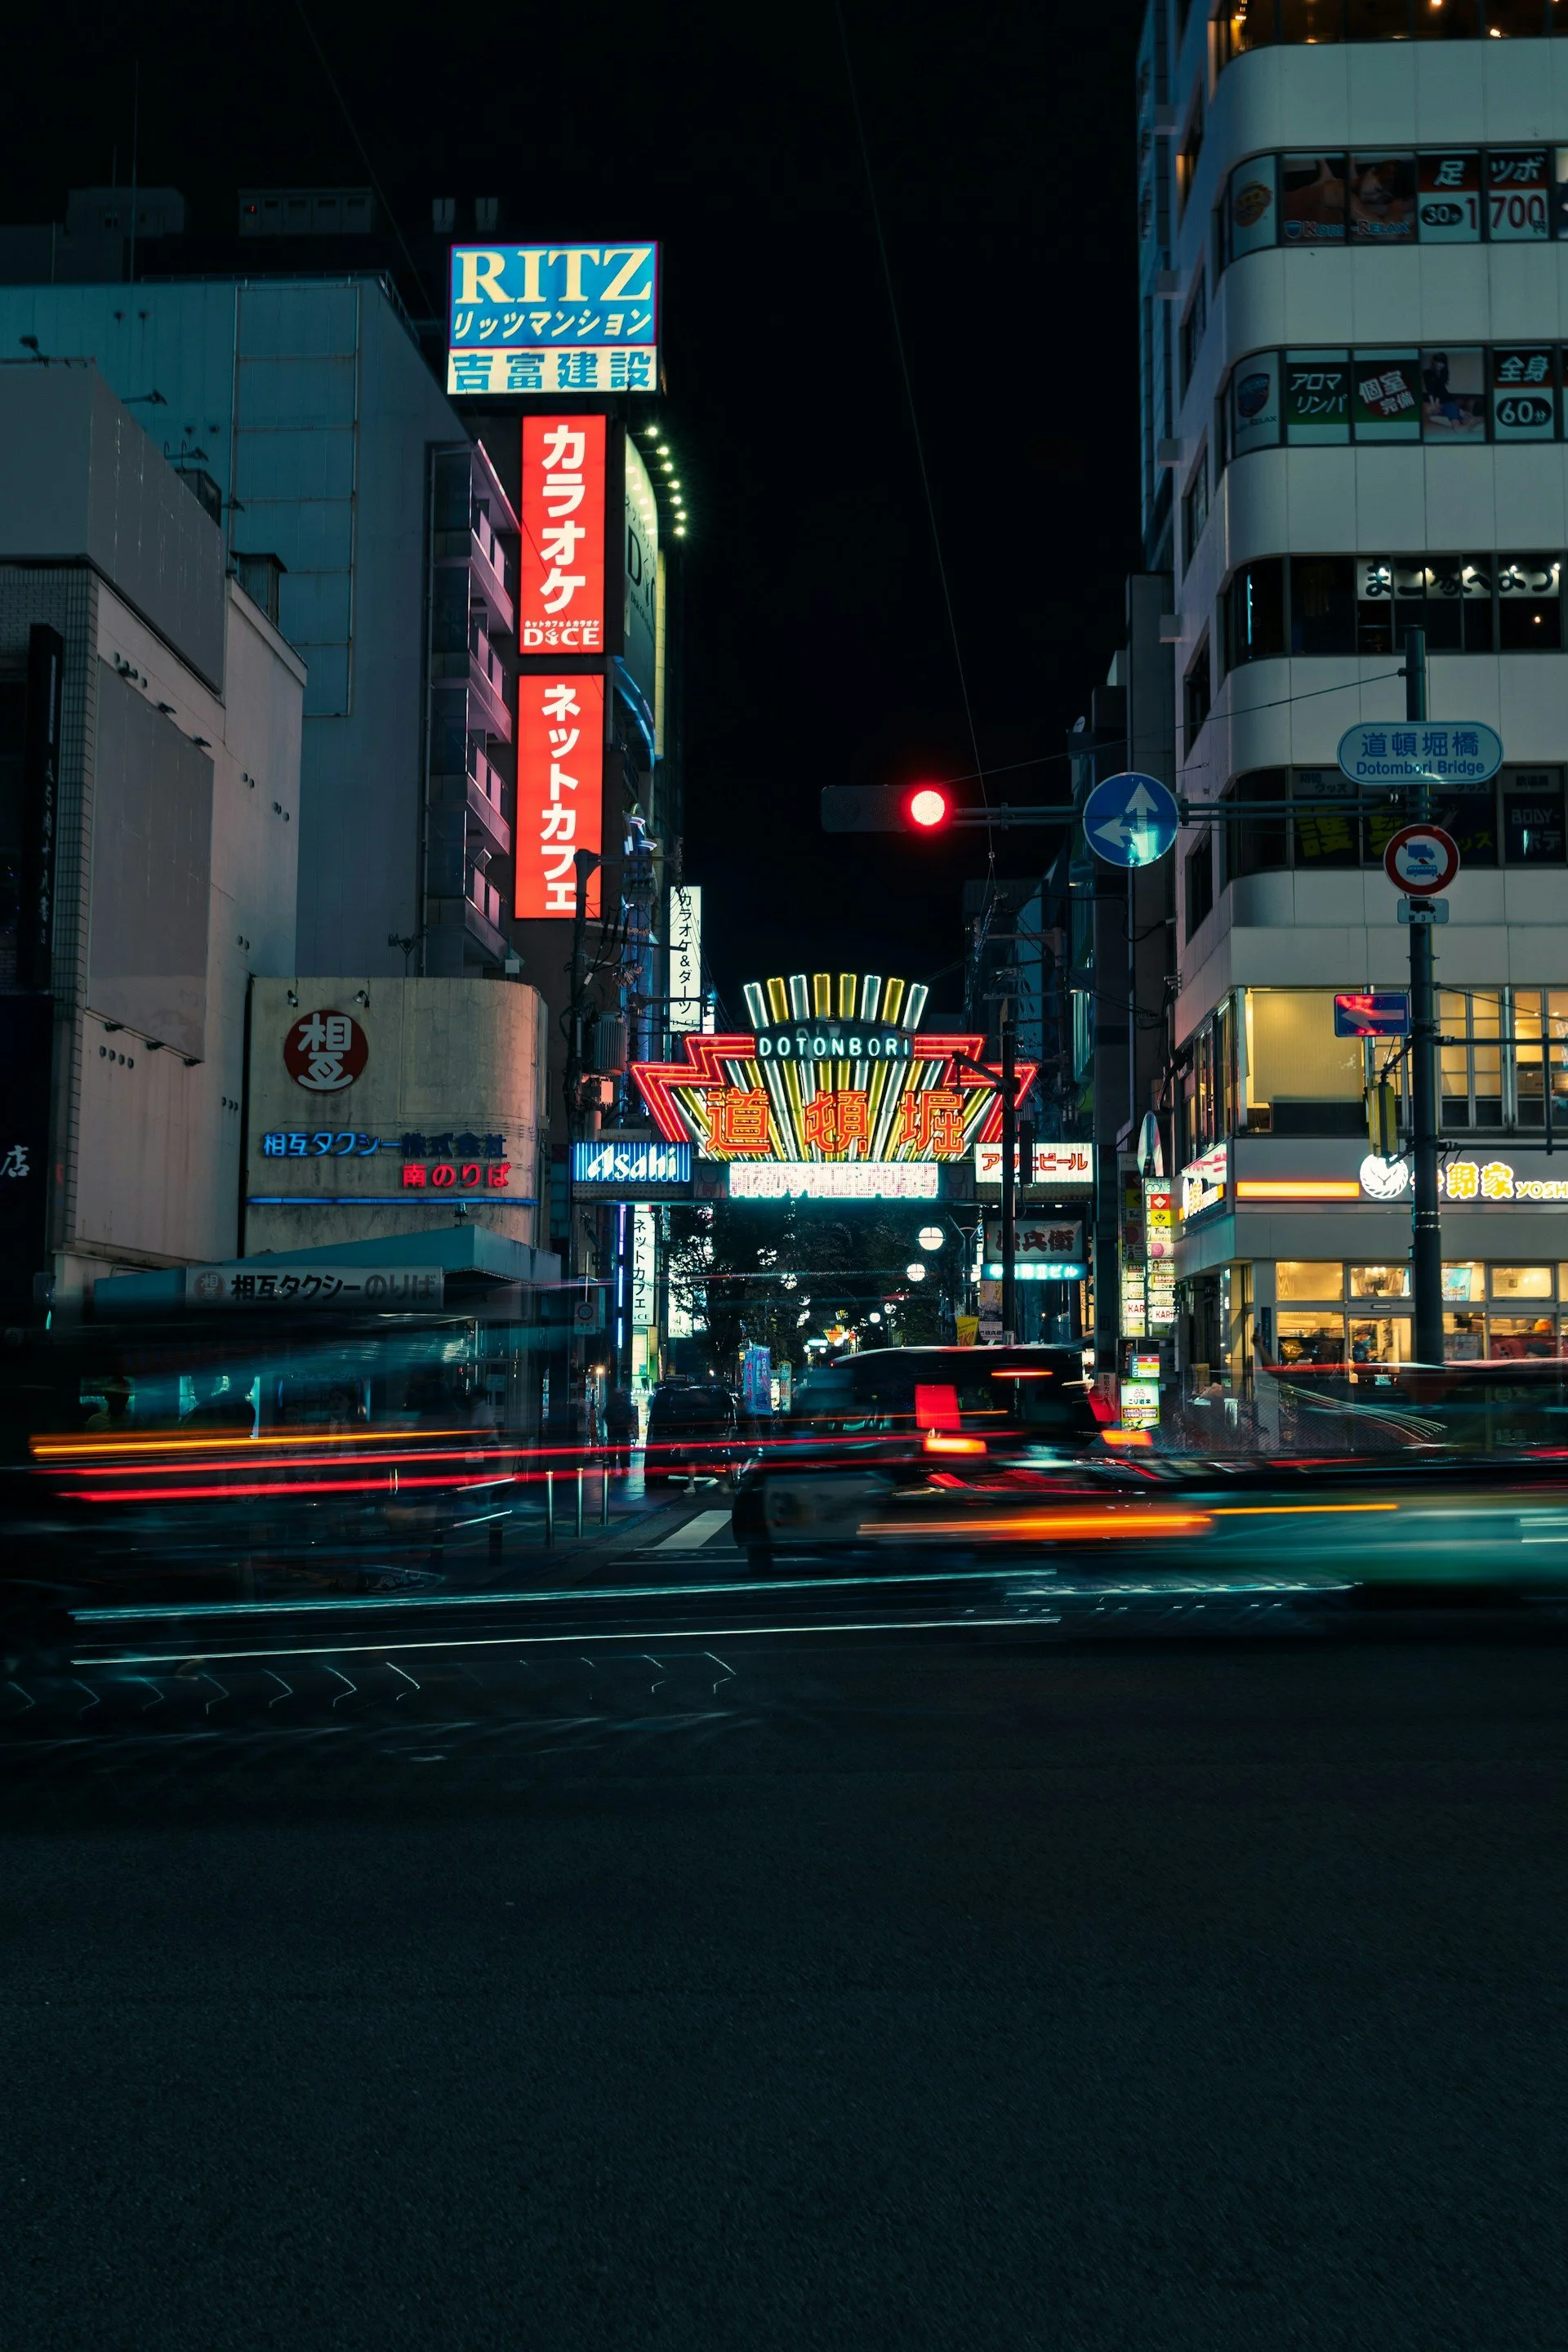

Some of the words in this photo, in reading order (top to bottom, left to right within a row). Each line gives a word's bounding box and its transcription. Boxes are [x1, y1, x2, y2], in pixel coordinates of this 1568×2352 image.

[454, 247, 653, 305] RITZ
[453, 310, 653, 340] リッツマンション
[453, 351, 651, 391] 吉富建設
[1290, 372, 1343, 392] アロマ
[1496, 354, 1550, 384] 全身
[1358, 369, 1409, 403] 個室
[1297, 393, 1349, 415] リンパ
[541, 425, 586, 615] カラオケ
[1361, 732, 1479, 758] 道頓堀橋
[1356, 760, 1432, 775] Dotombori
[1438, 760, 1485, 777] Bridge
[540, 684, 581, 911] ネットカフェ
[759, 1036, 910, 1057] DOTONBORI
[706, 1089, 965, 1153] 道頓堀
[402, 1162, 511, 1188] 南のりば
[587, 1145, 677, 1183] Asahi
[982, 1152, 1089, 1171] アビール
[1411, 1162, 1513, 1199] 野家
[634, 1219, 646, 1308] ネットカフェ
